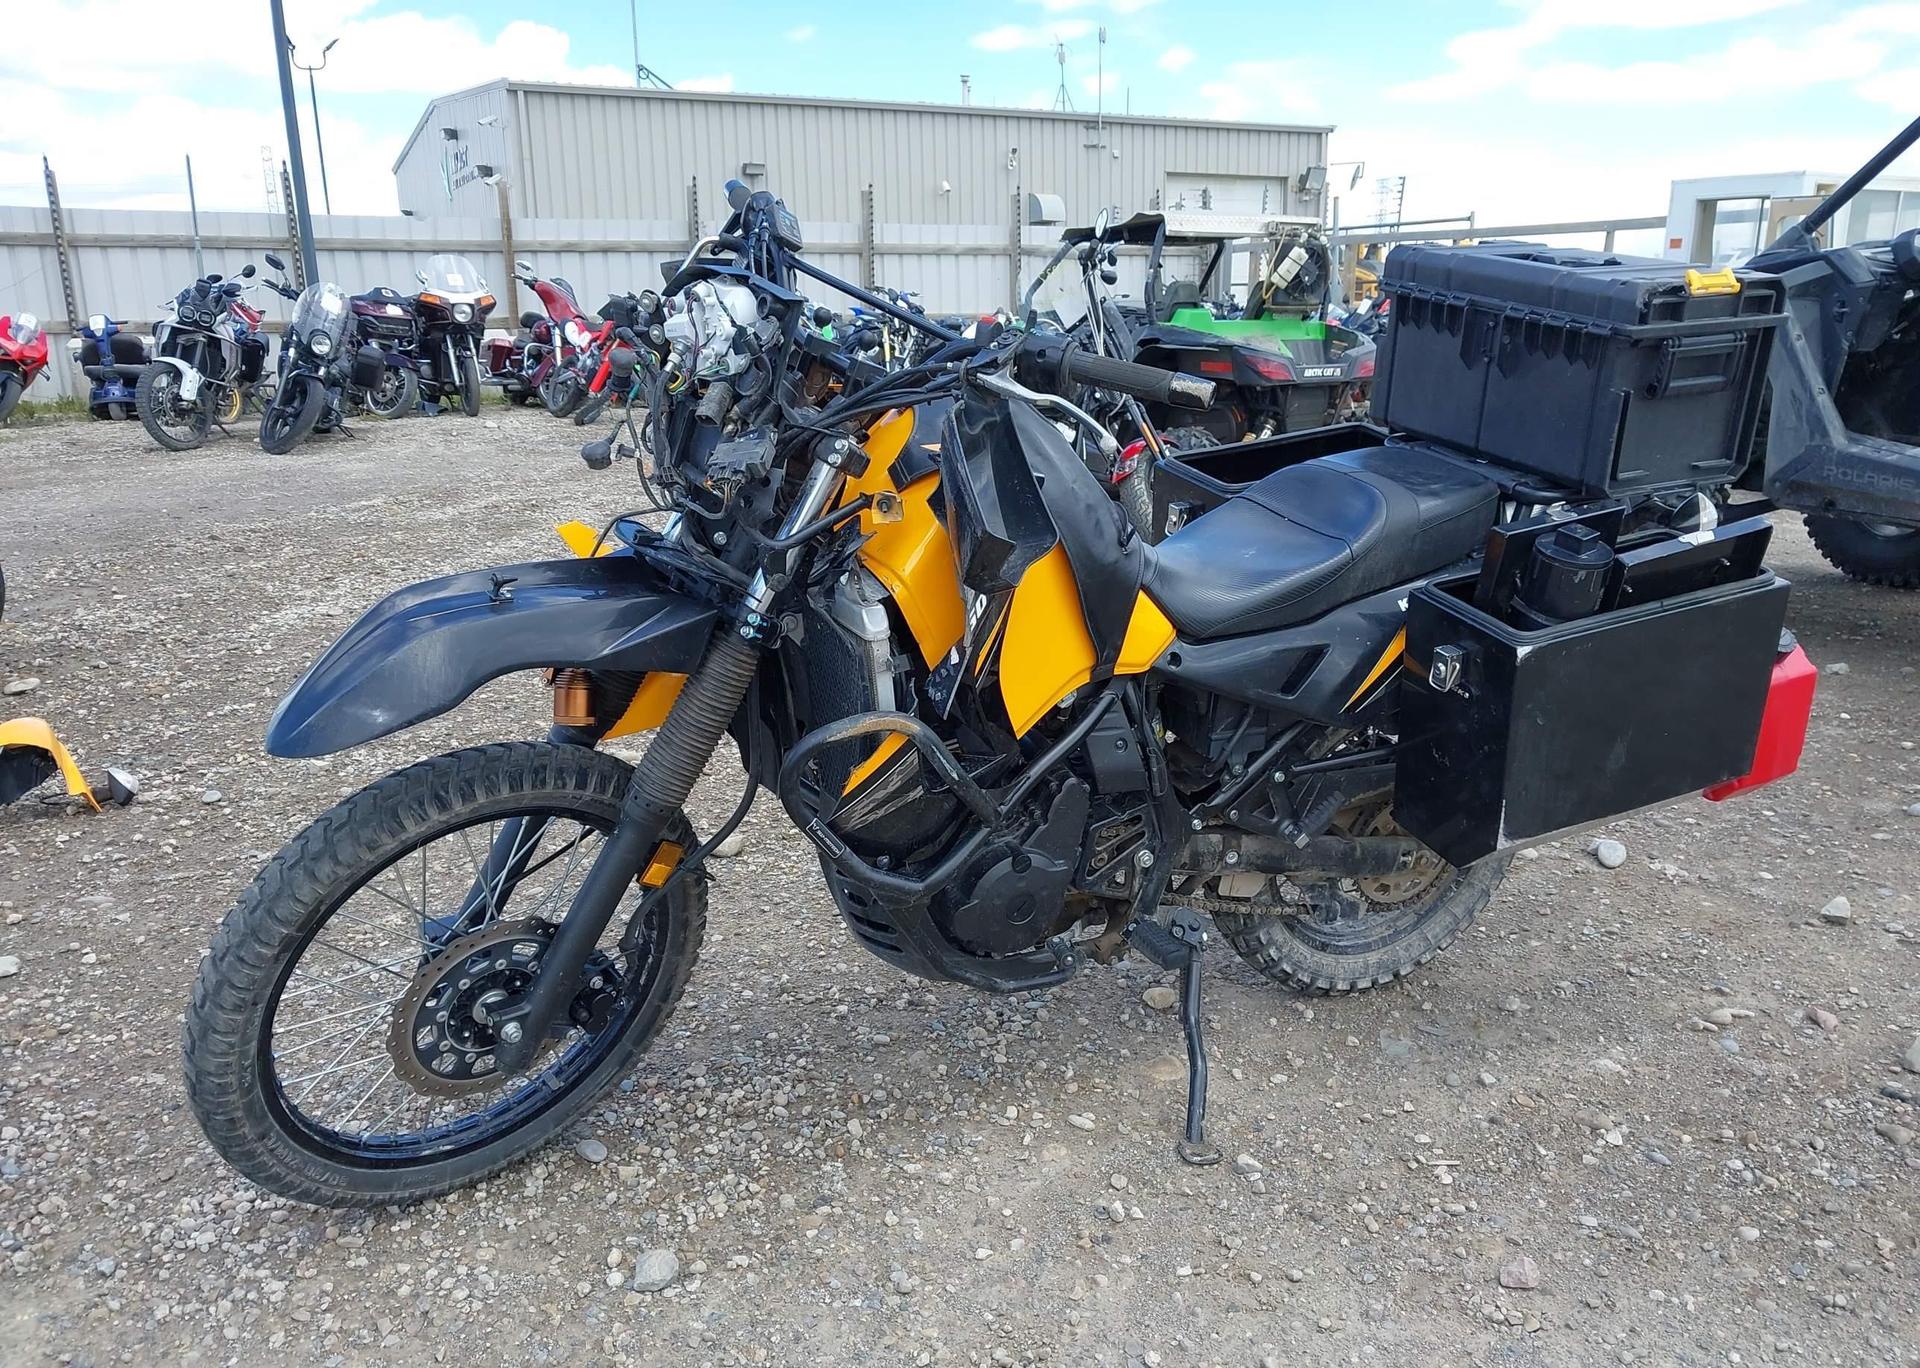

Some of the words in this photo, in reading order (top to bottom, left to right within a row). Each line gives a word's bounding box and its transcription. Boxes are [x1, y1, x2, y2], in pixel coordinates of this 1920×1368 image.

[1303, 367, 1323, 377] ARCTIC
[1323, 367, 1334, 377] CAT
[1823, 465, 1916, 490] POLARIS
